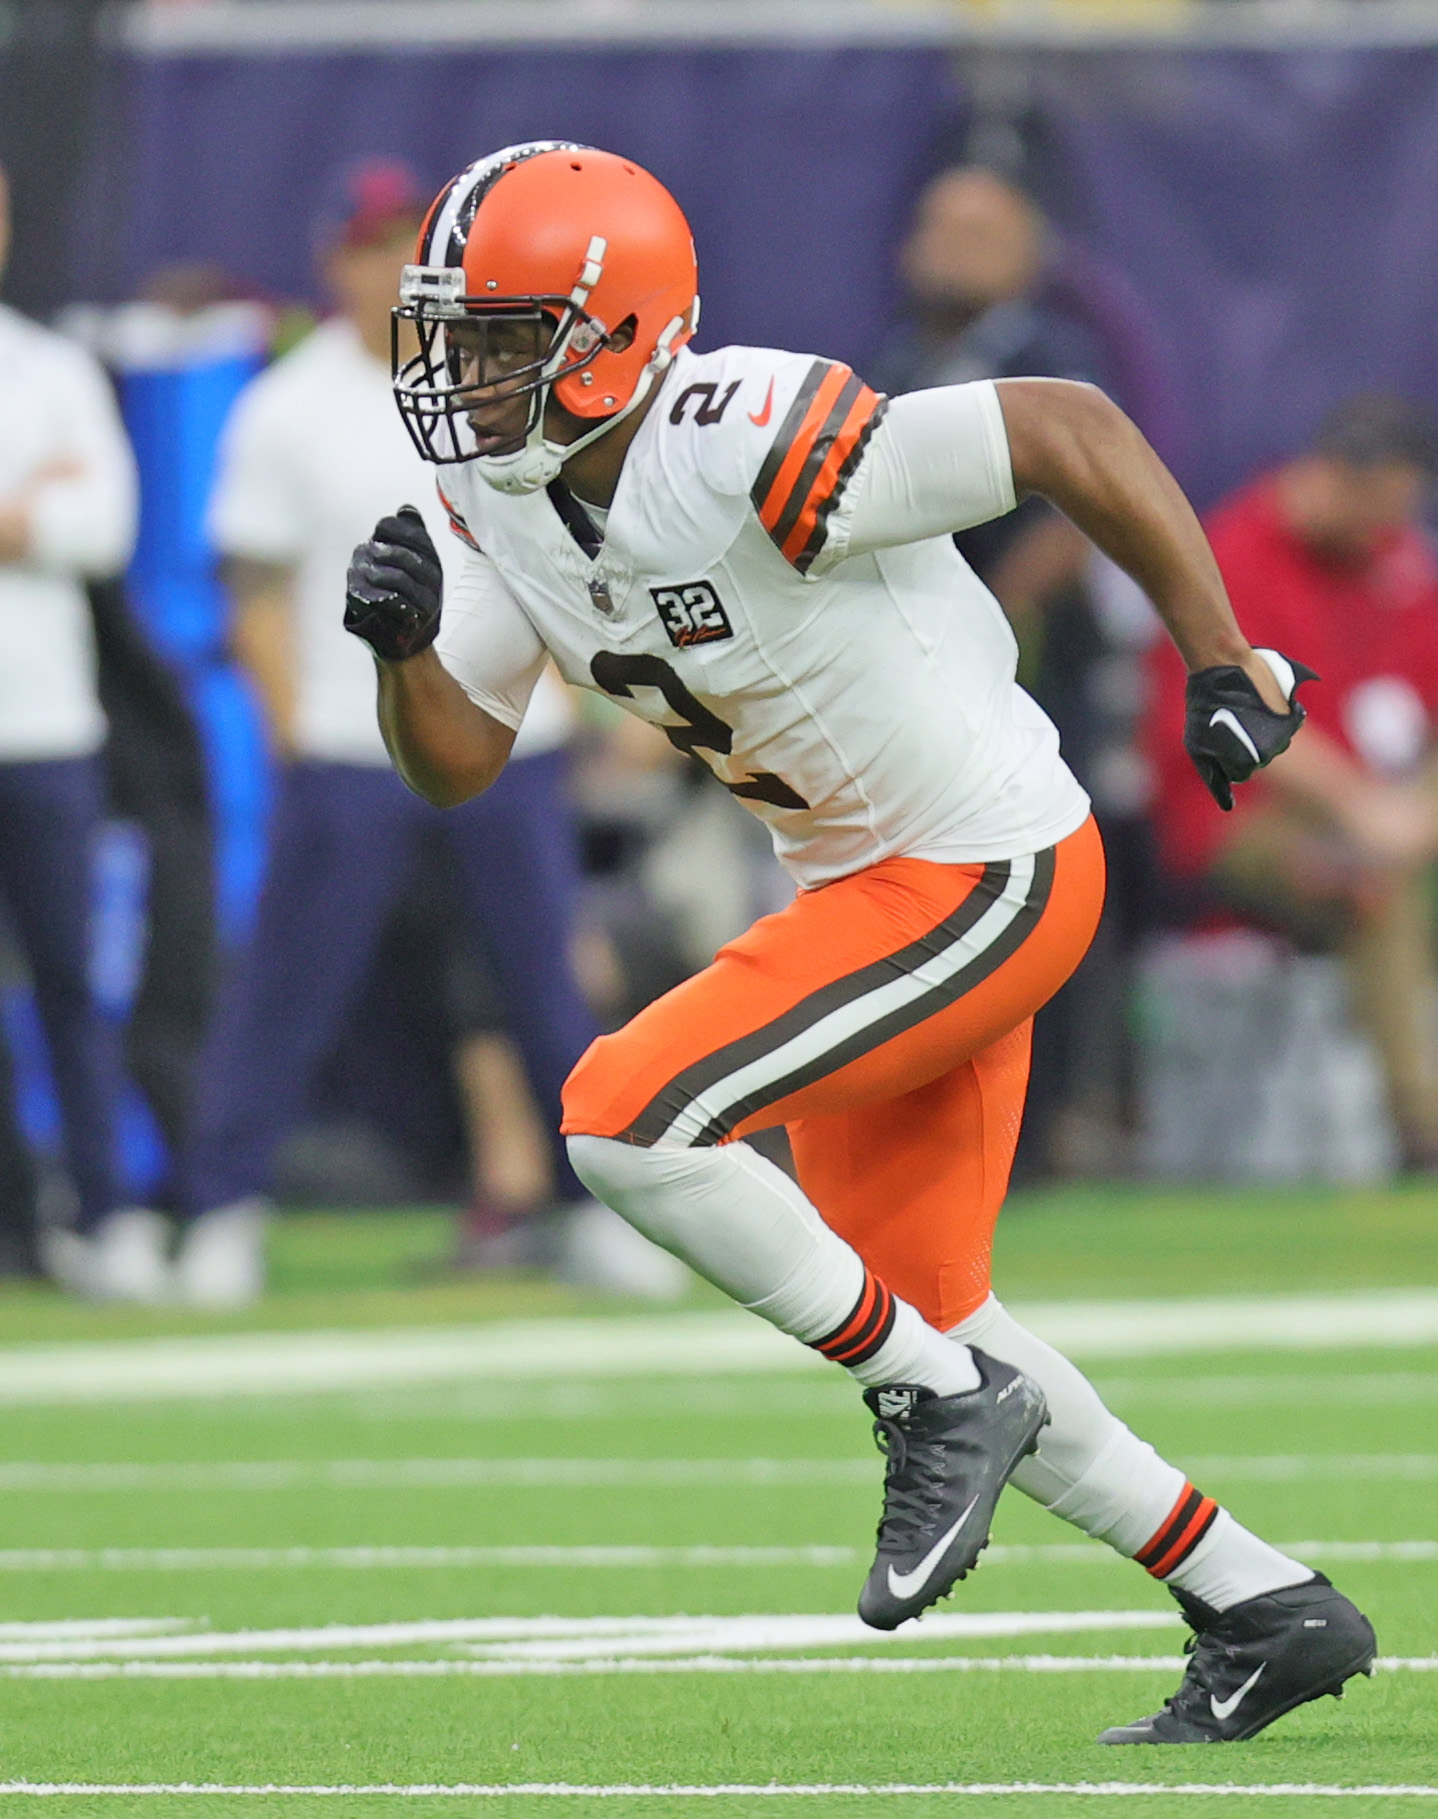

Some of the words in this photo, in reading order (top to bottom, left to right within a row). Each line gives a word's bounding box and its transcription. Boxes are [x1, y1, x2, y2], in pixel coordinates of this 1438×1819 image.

[669, 379, 742, 427] 2
[657, 586, 724, 633] 32
[590, 650, 811, 811] 2
